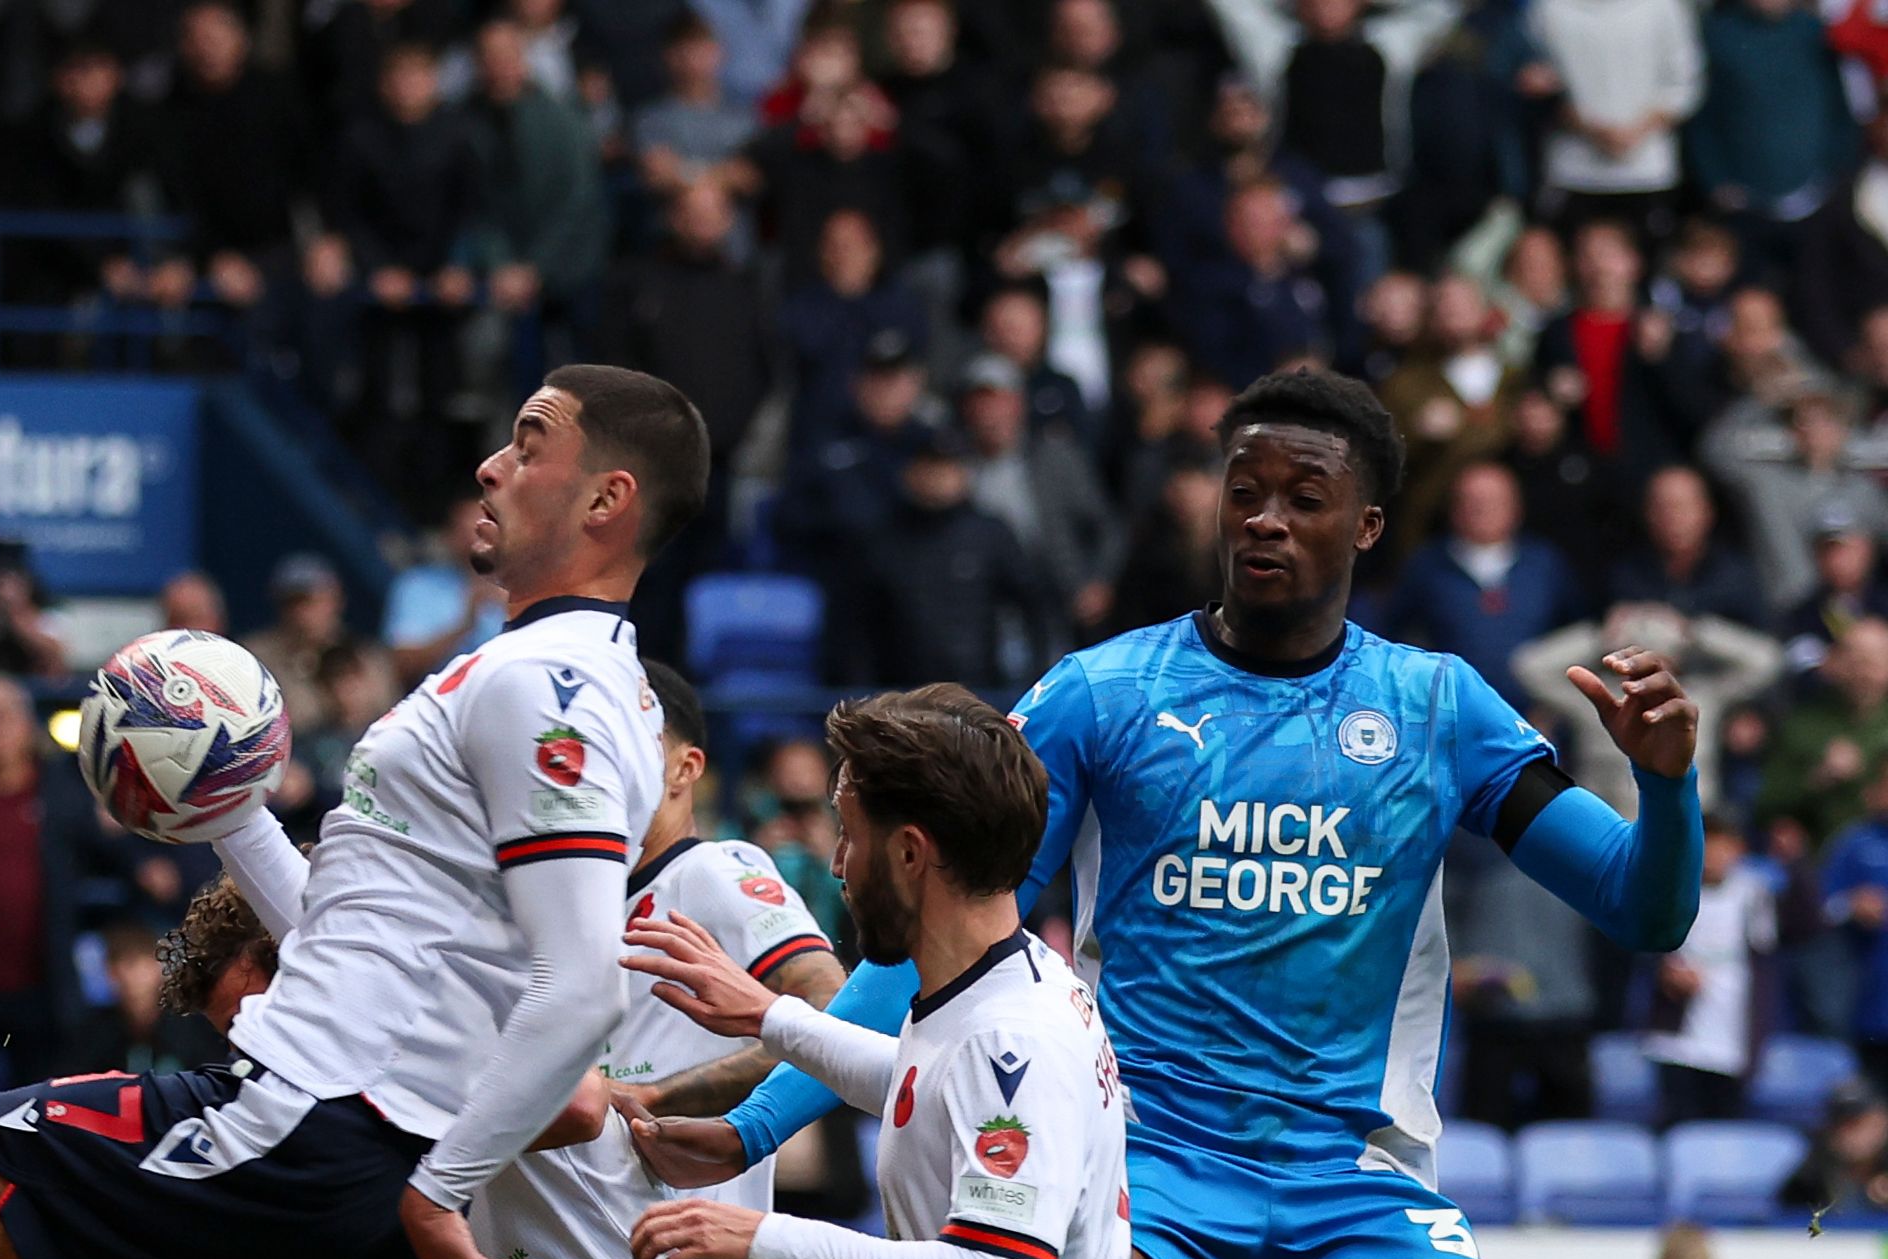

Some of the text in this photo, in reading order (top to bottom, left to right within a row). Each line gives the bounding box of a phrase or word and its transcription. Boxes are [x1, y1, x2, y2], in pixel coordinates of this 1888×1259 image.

[1198, 799, 1351, 859] MICK
[1152, 853, 1383, 916] GEORGE
[969, 1182, 1025, 1206] whites
